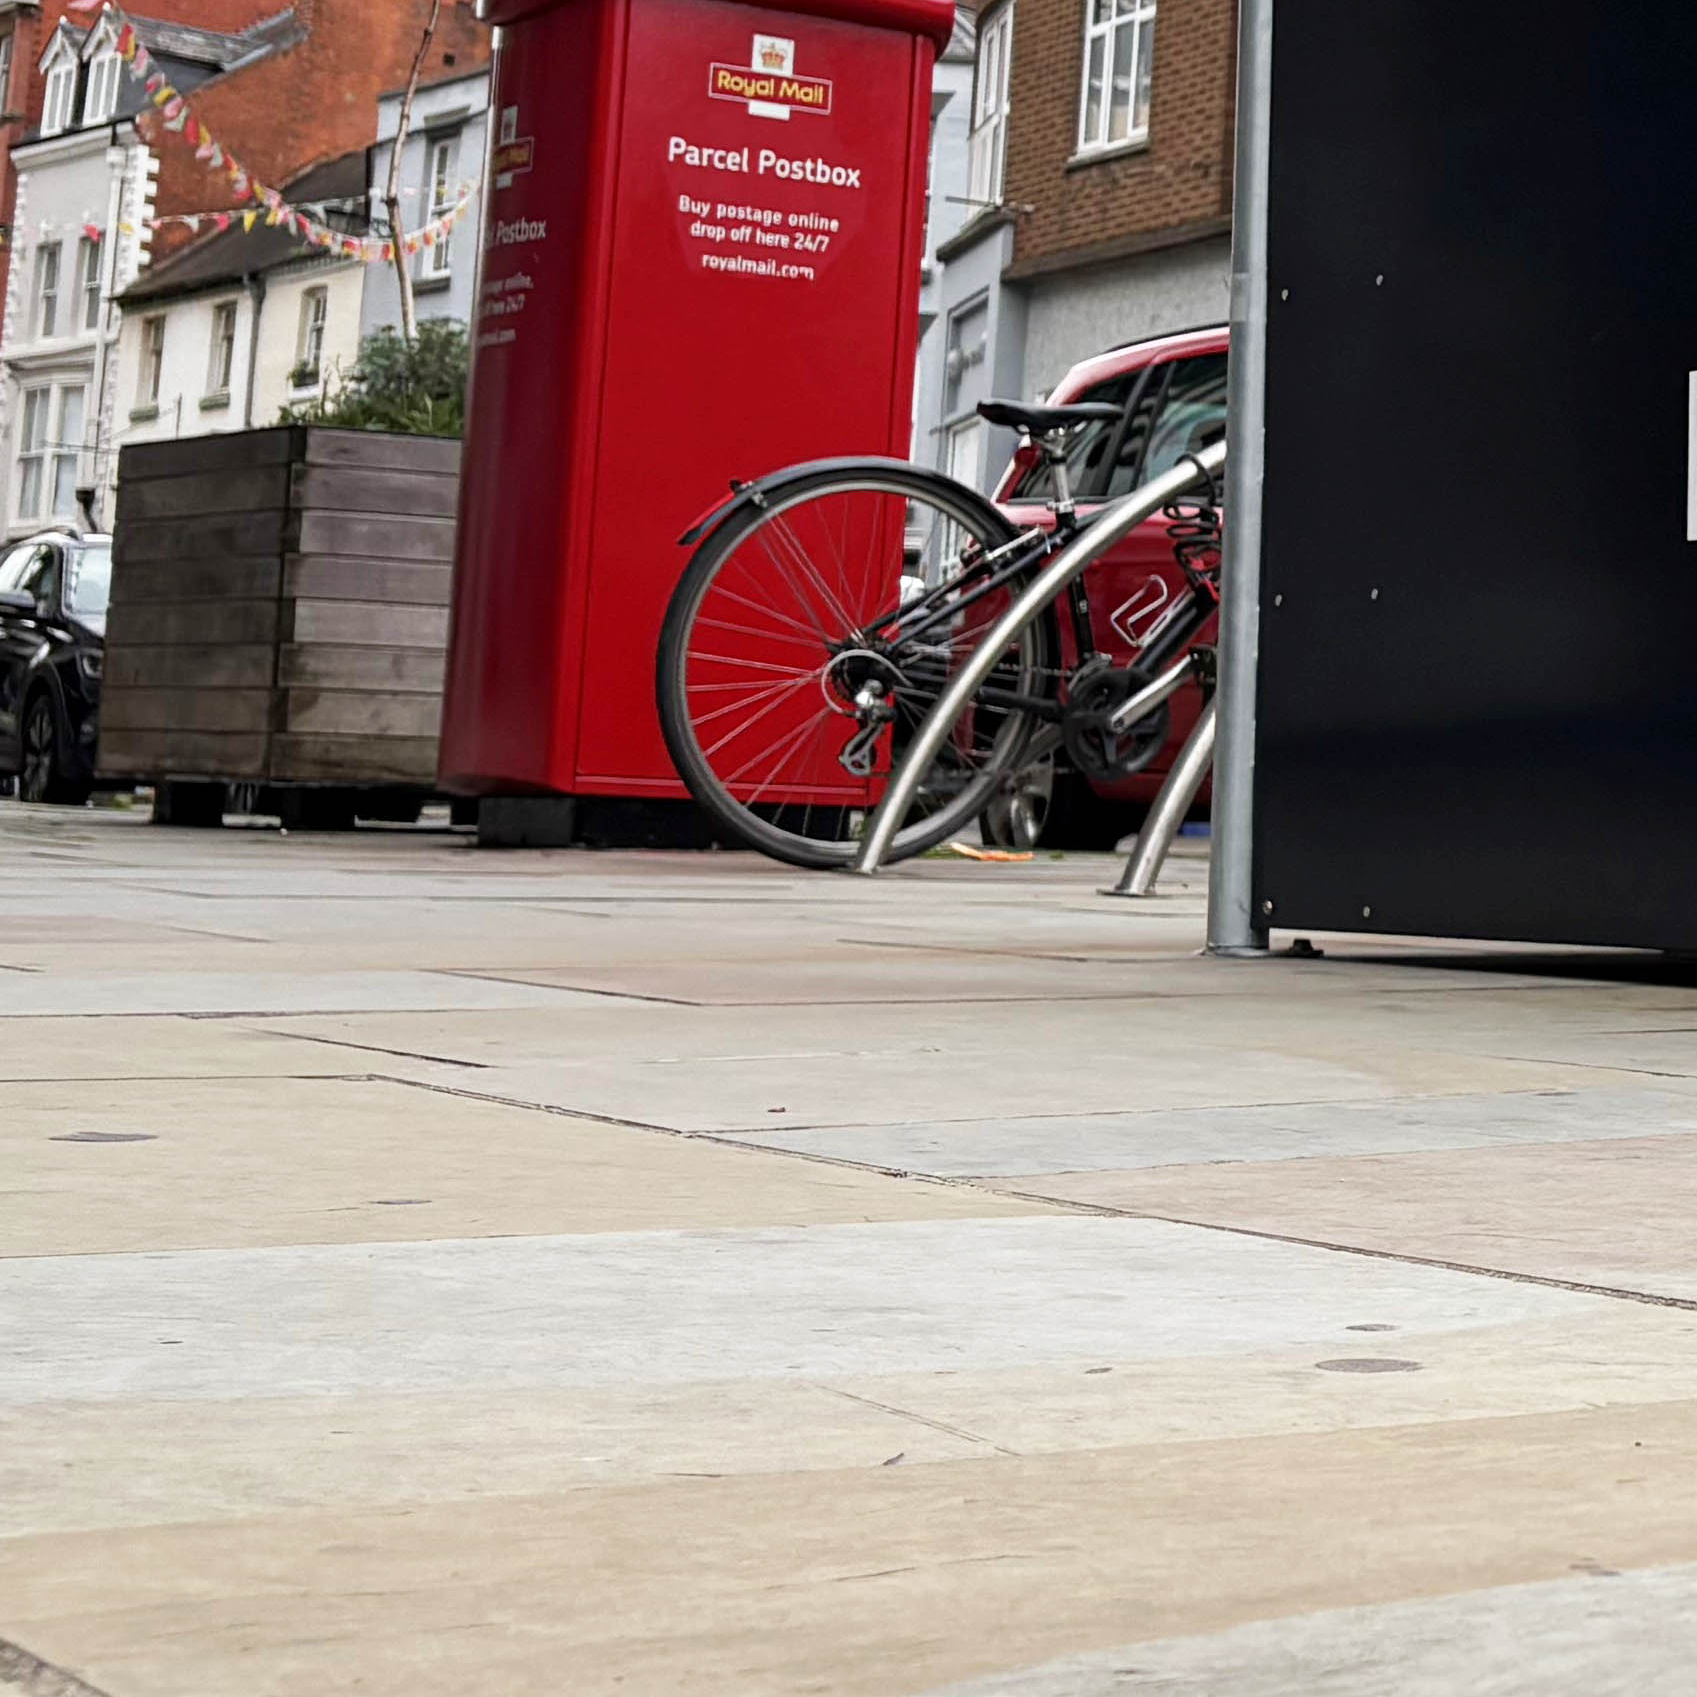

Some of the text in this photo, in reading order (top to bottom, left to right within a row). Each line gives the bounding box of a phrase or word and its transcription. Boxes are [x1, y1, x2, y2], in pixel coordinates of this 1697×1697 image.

[717, 69, 824, 105] Royal Mail
[667, 135, 861, 188] Parcel Postbox
[679, 193, 840, 233] Buy postage online
[690, 219, 830, 253] drop off here 24/7
[702, 252, 815, 281] royalmail.com
